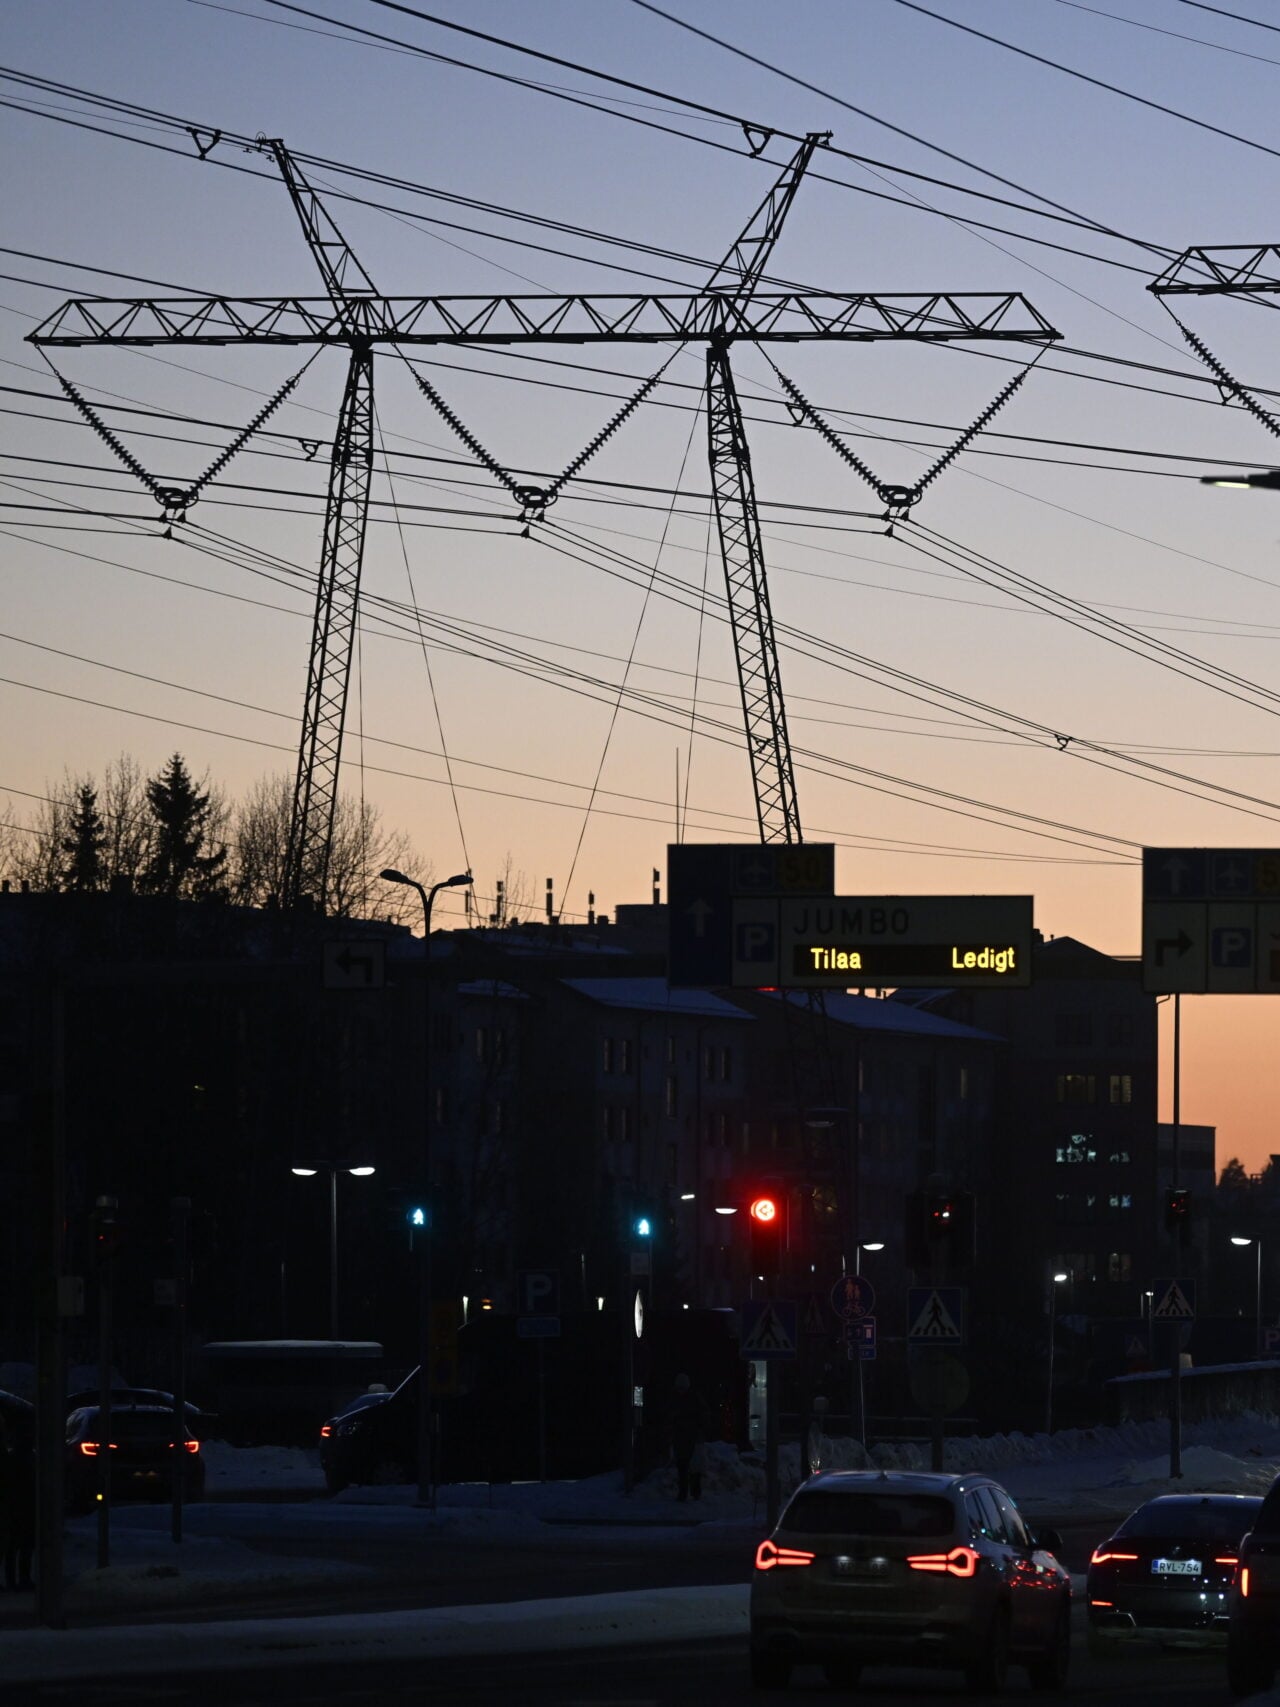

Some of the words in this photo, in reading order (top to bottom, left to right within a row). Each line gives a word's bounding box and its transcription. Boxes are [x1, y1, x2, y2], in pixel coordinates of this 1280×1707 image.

[784, 856, 821, 883] 50
[794, 907, 910, 935] JUMBO
[810, 947, 862, 970] Tilaa
[952, 946, 1016, 973] Ledigt
[1159, 1562, 1199, 1573] RVL-754
